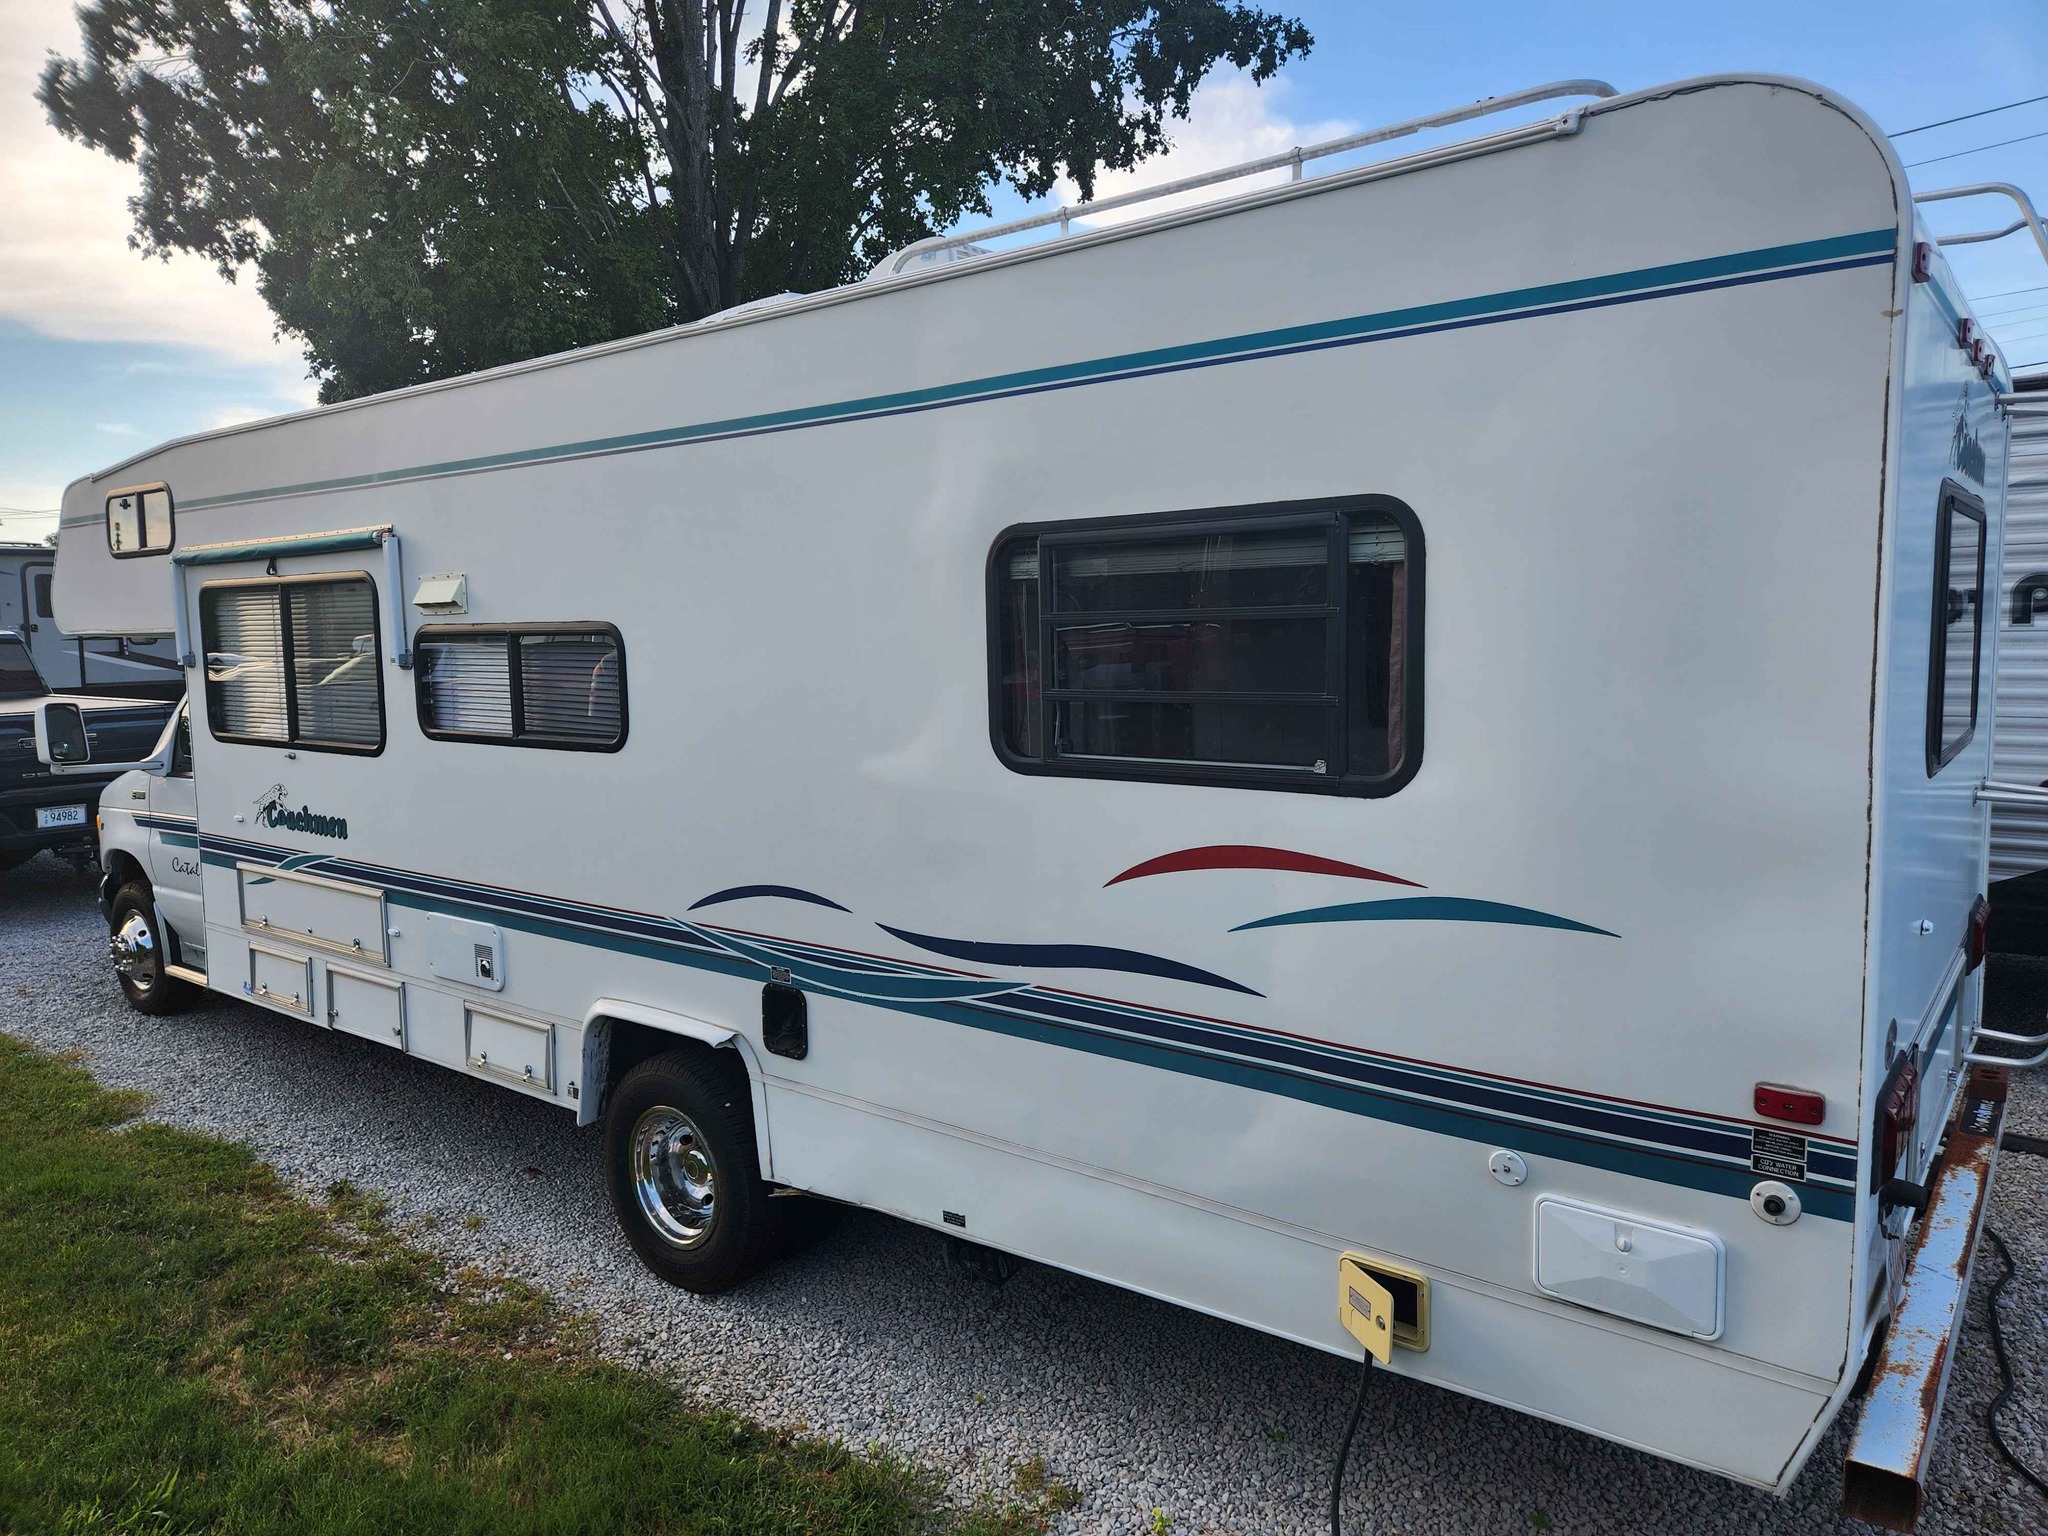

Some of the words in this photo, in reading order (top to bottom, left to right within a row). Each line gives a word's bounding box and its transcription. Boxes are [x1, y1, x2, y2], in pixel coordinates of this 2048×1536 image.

[50, 810, 78, 822] 94982
[266, 801, 348, 840] Coachmen
[1757, 1164, 1799, 1177] CONNECTION
[1760, 1158, 1774, 1166] CITY
[1775, 1161, 1797, 1171] WATER
